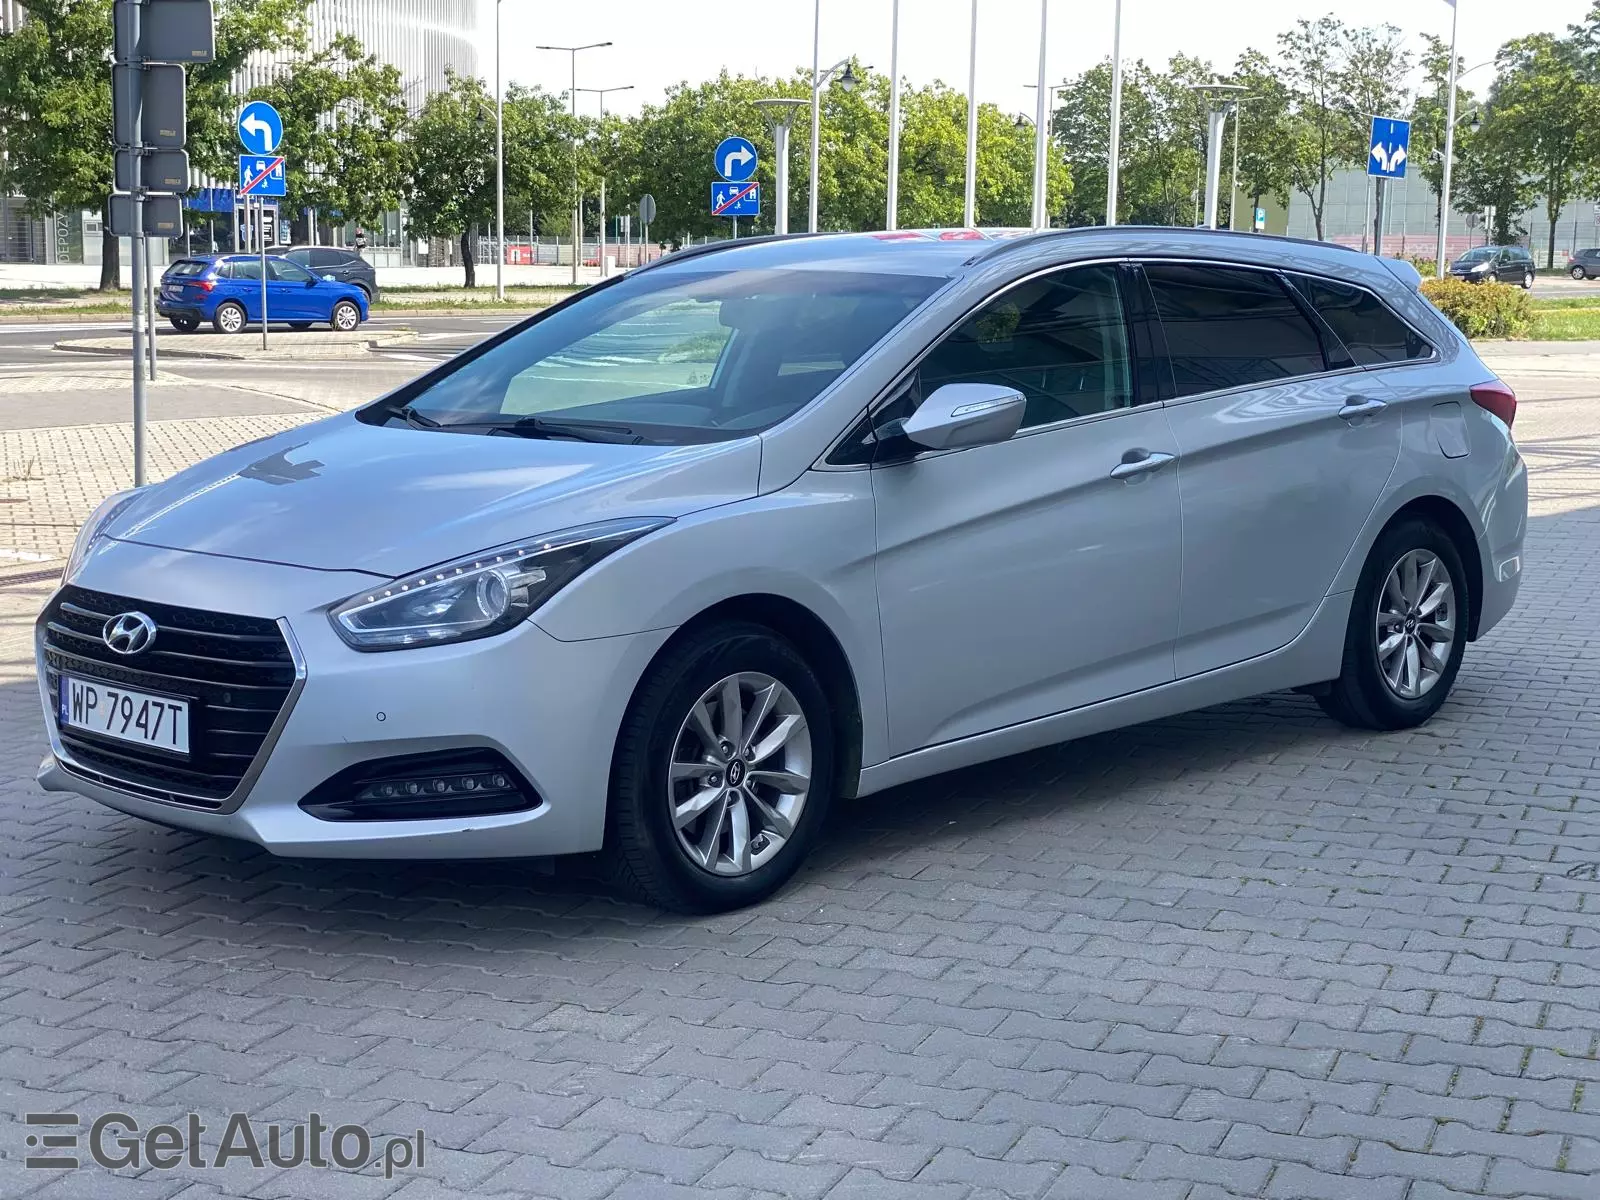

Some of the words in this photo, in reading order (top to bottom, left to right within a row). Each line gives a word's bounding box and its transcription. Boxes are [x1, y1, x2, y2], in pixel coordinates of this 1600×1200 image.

[61, 703, 69, 716] PL
[73, 684, 97, 724] WP
[107, 692, 182, 744] 7947T
